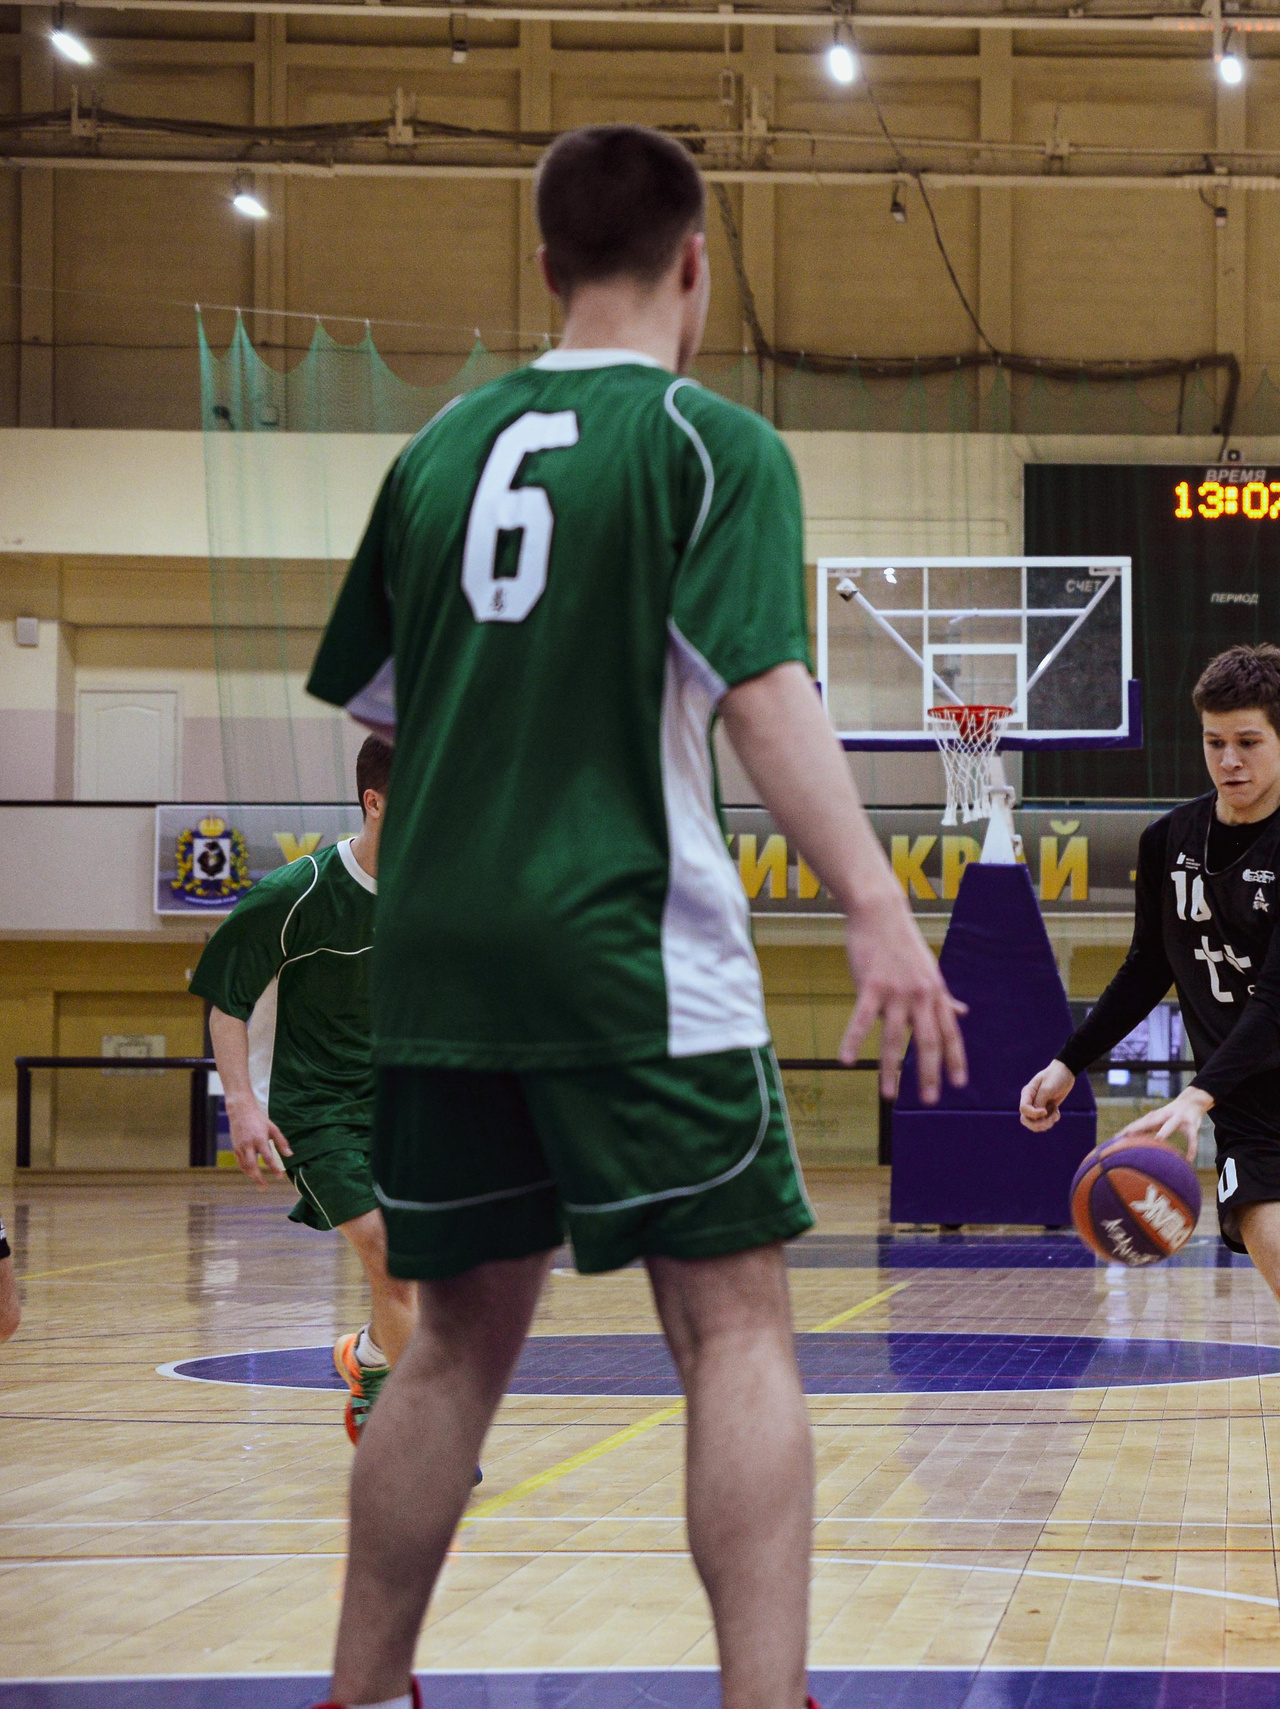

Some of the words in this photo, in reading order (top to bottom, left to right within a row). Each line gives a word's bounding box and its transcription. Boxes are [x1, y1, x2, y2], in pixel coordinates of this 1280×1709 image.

[1205, 469, 1267, 483] ВРЕМЯ
[461, 410, 579, 623] 6
[1210, 592, 1259, 605] ПЕРИОД
[891, 820, 1089, 900] КРЙ
